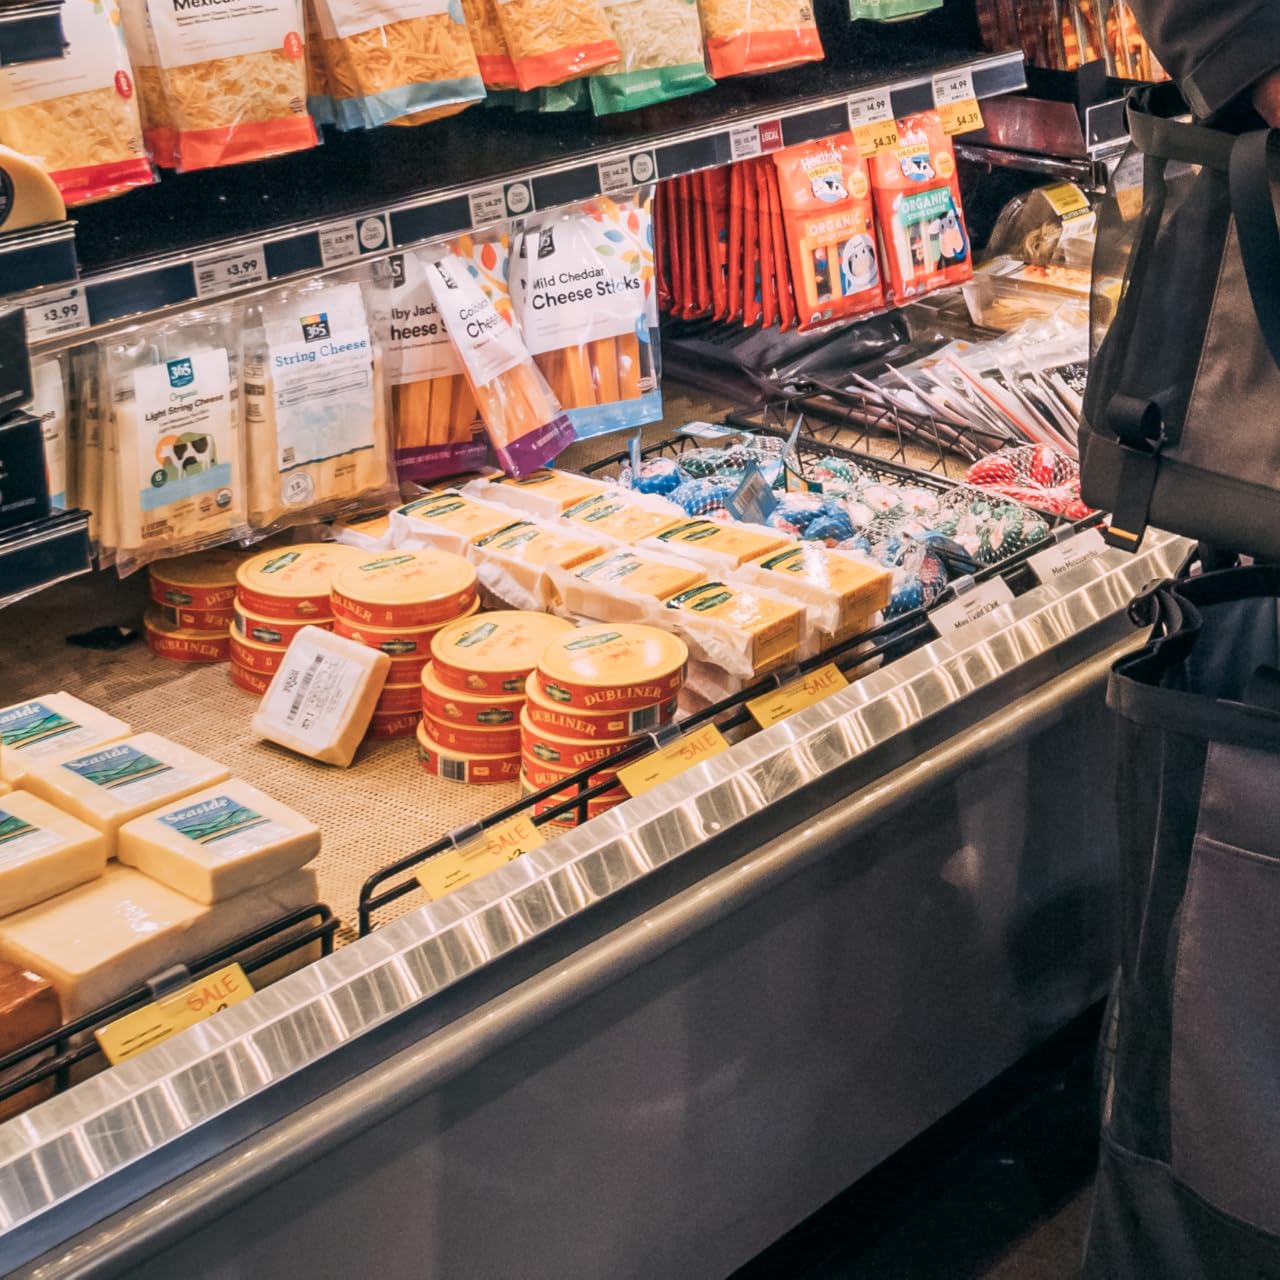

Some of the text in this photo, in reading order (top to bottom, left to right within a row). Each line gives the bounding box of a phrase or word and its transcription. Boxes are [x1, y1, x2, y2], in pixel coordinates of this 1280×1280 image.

[949, 79, 967, 92] $4.99
[867, 99, 886, 112] $4.99
[956, 113, 979, 127] $4.39
[761, 130, 780, 143] LOCAL
[872, 134, 898, 150] $4.39
[896, 144, 928, 158] ORGANIC
[902, 191, 949, 214] ORGANIC
[809, 214, 862, 237] ORGANIC
[226, 260, 258, 276] $3.99
[532, 267, 605, 290] Mild Cheddar
[532, 276, 640, 310] Cheese Sticks
[44, 303, 79, 321] $3.99
[413, 304, 438, 318] Jack
[305, 324, 327, 339] 365
[390, 323, 438, 341] heese
[275, 339, 367, 369] String Cheese
[171, 363, 191, 379] 365
[145, 394, 224, 422] Light String Cheese
[331, 594, 372, 623] BLINER
[804, 671, 841, 696] SALE
[584, 685, 662, 706] DUBLINER
[0, 702, 42, 725] aside
[531, 710, 597, 736] DUBLINER
[573, 742, 630, 765] DUBLI
[679, 731, 717, 761] SALE
[67, 745, 131, 771] Seaside
[162, 797, 230, 825] Seaside
[486, 823, 529, 855] SALE
[186, 972, 240, 1012] SALE
